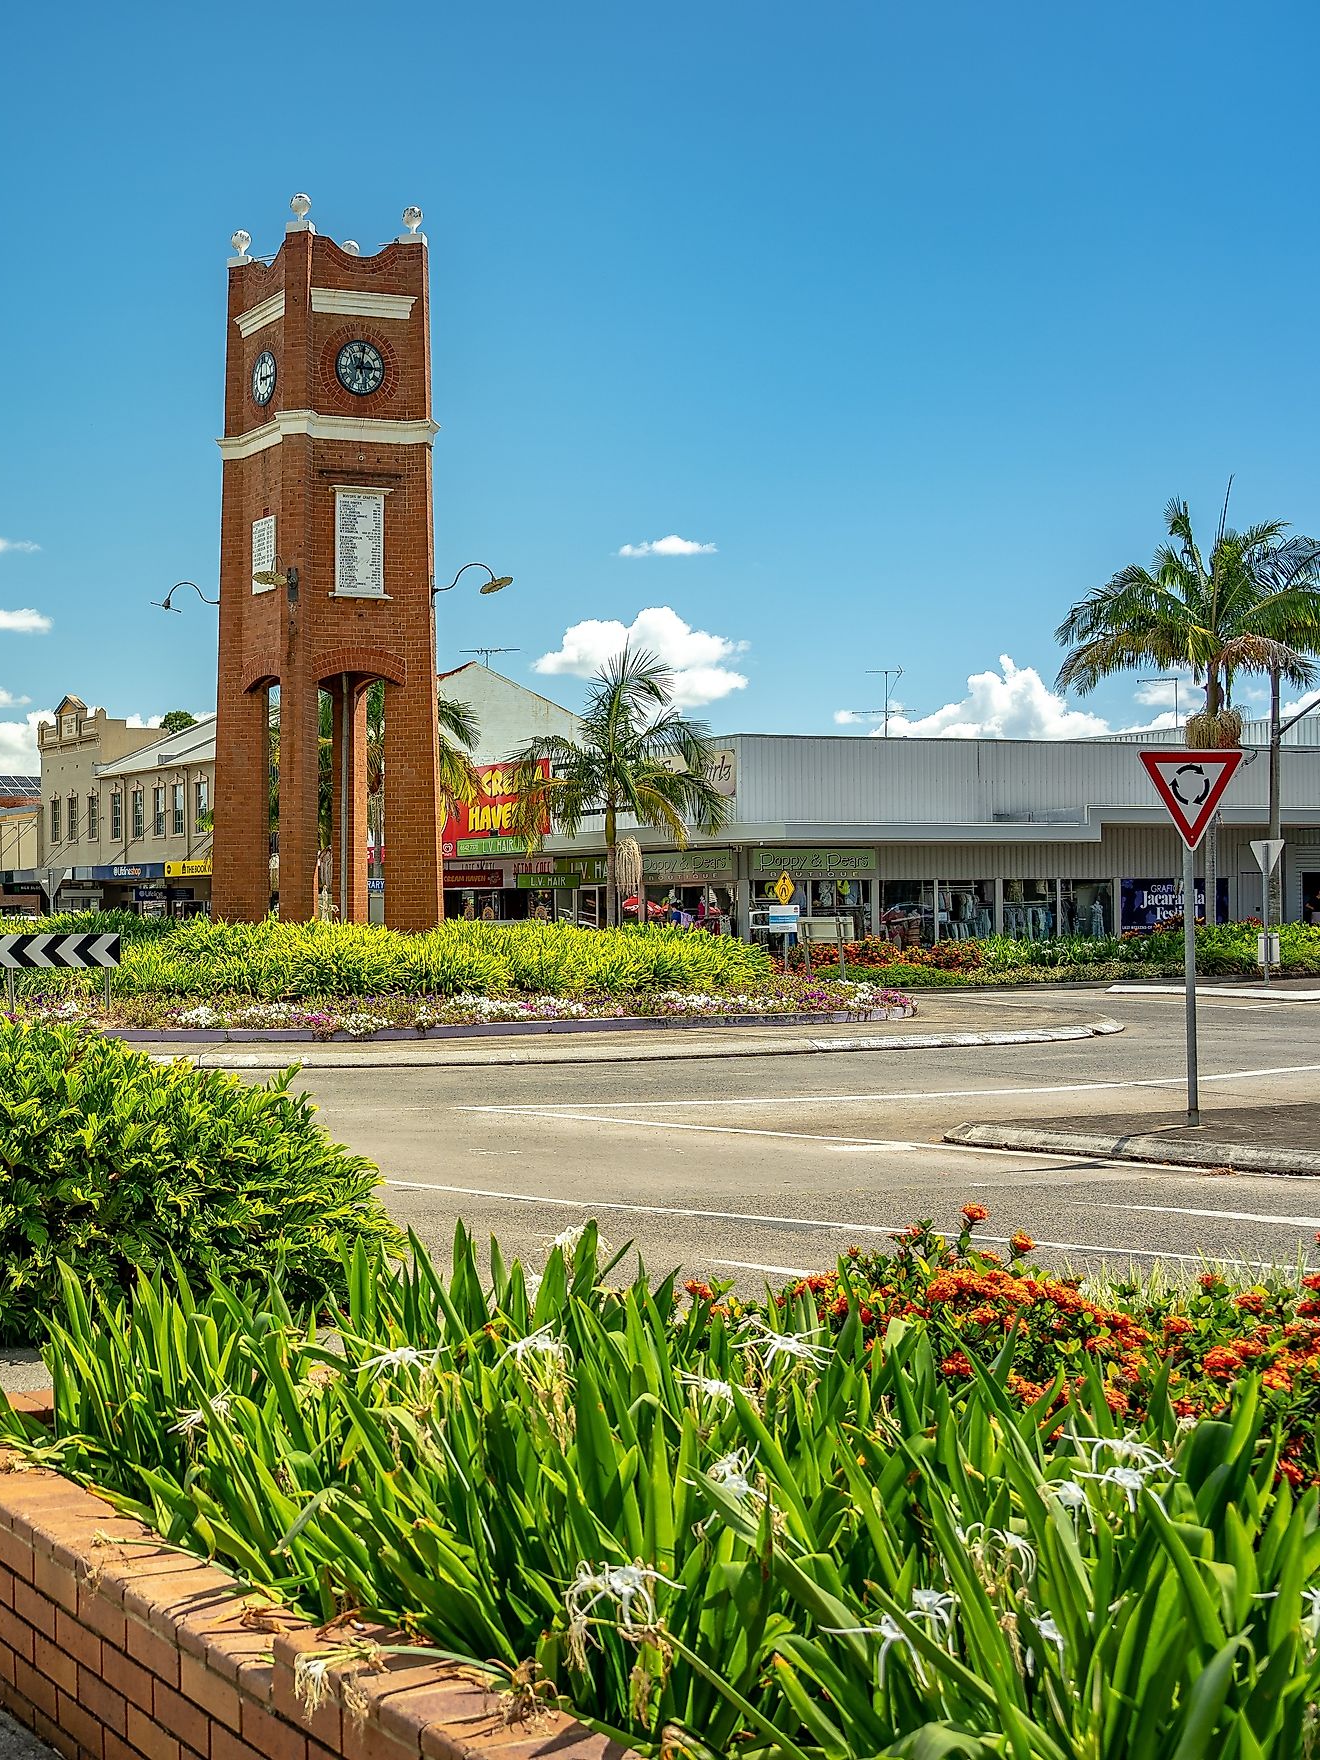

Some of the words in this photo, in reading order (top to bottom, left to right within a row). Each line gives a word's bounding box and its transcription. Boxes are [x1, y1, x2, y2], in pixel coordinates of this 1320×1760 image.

[496, 839, 514, 852] HAIR
[679, 857, 689, 870] &
[692, 855, 727, 875] Pears
[759, 852, 807, 871] Poppy
[811, 853, 822, 867] &
[826, 853, 869, 871] Pears
[547, 876, 566, 886] HAIR
[1151, 884, 1179, 893] GRAFT
[1140, 888, 1206, 909] Jacaraa
[1155, 905, 1200, 920] Festil
